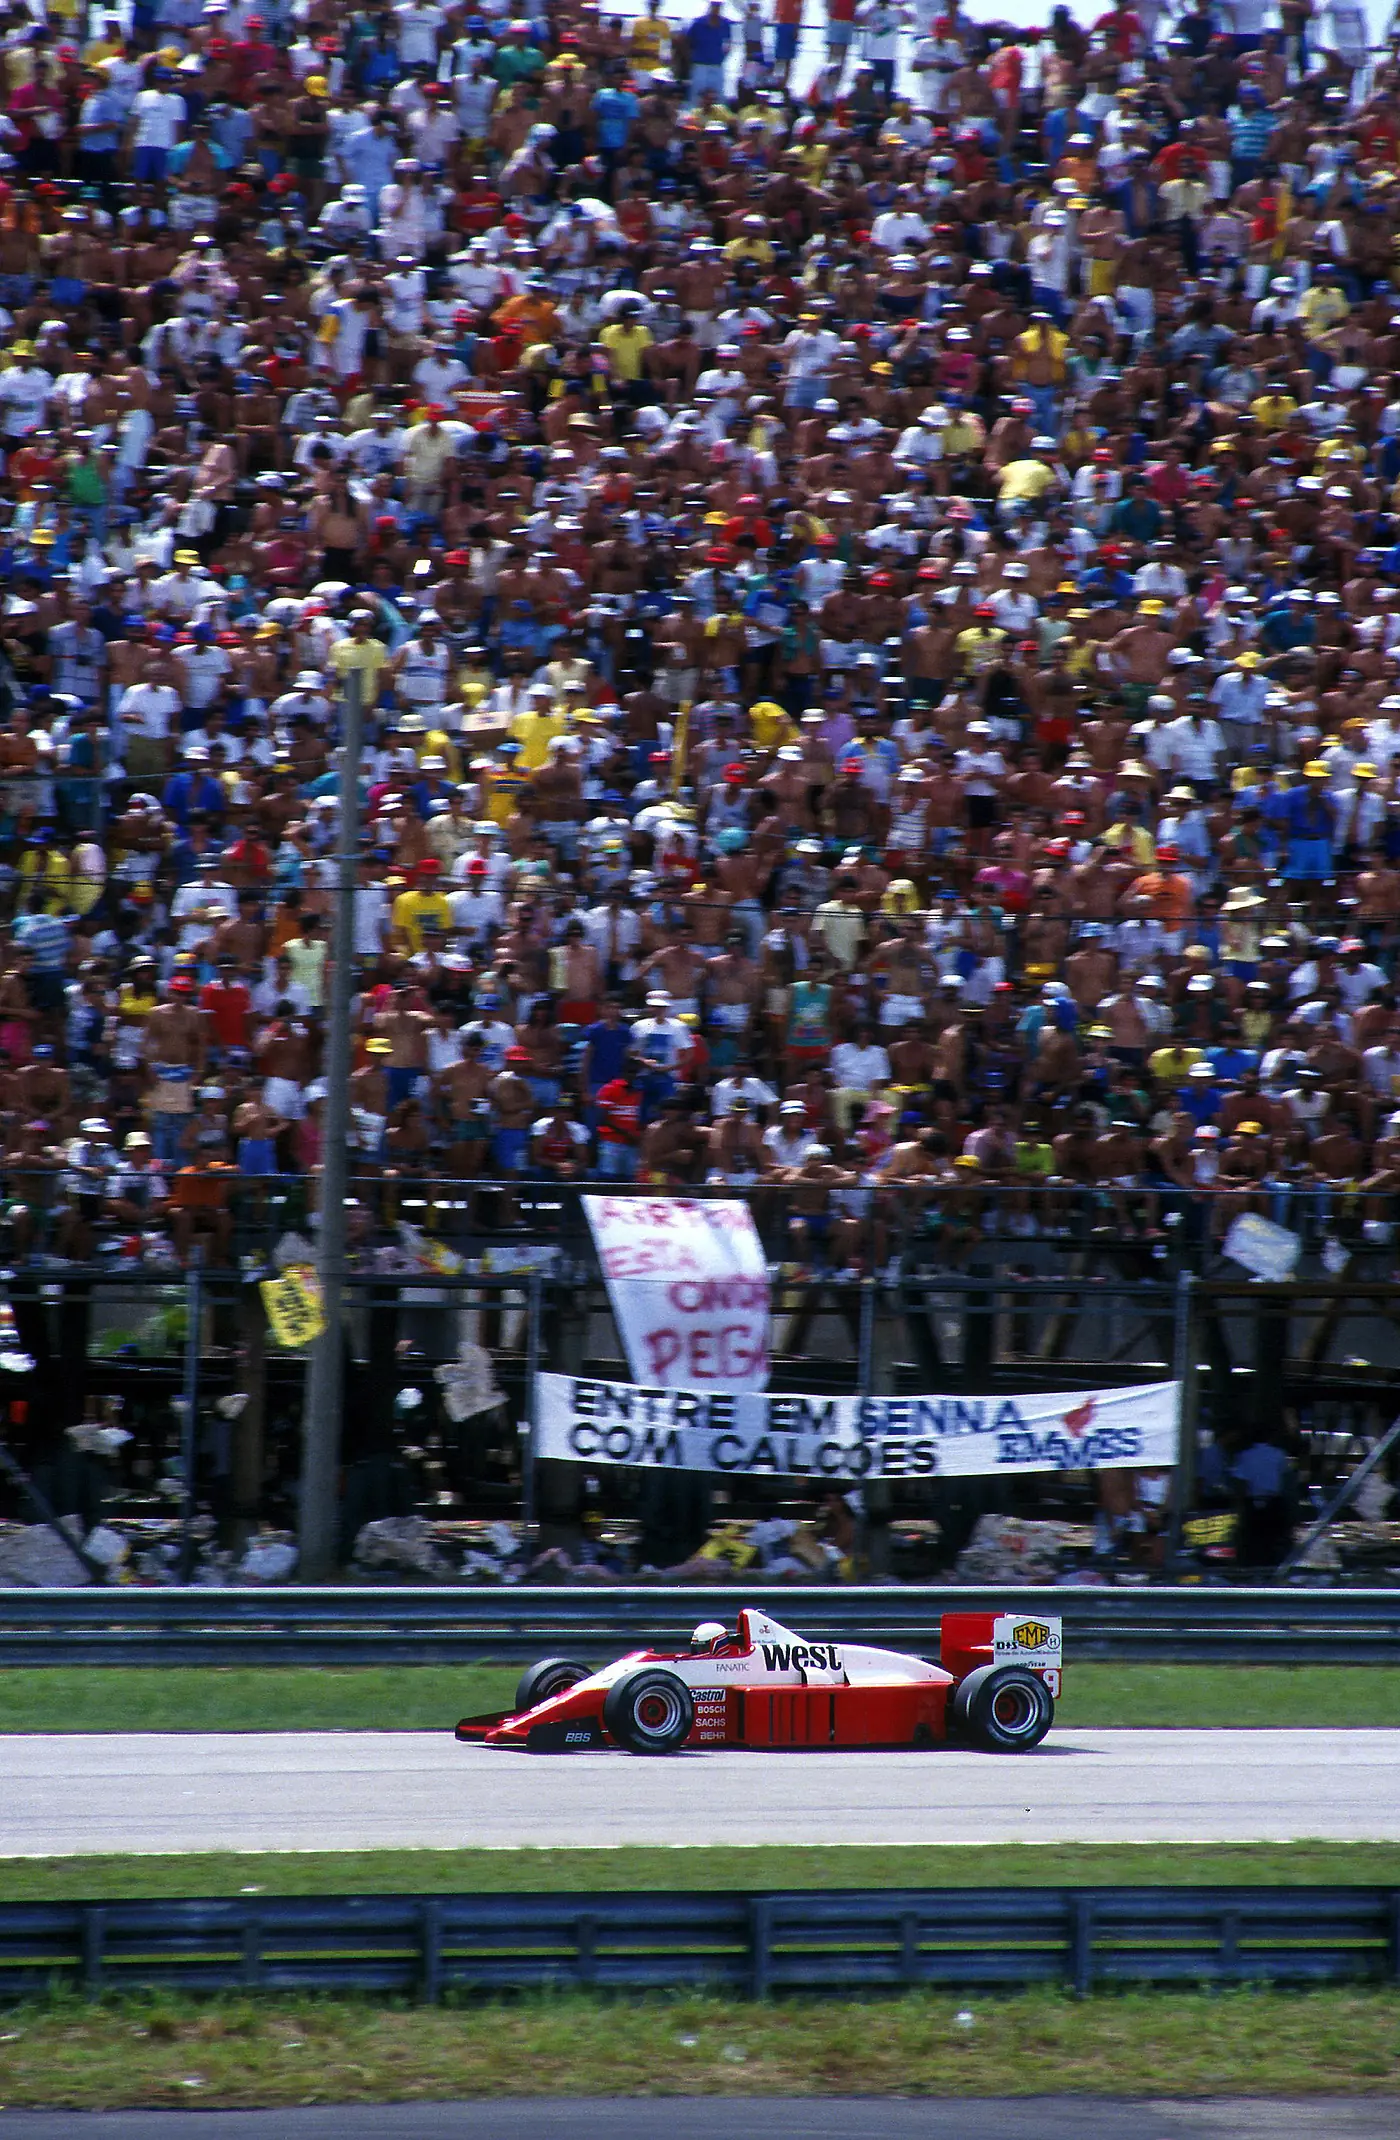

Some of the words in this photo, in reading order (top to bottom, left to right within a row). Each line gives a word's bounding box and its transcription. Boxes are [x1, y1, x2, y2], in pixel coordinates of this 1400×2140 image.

[572, 1381, 737, 1430] ENTRE
[767, 1397, 838, 1435] EM
[855, 1400, 1031, 1435] SENNA
[569, 1421, 682, 1466] COM
[1016, 1626, 1049, 1647] EMB
[760, 1644, 842, 1672] West
[716, 1663, 749, 1672] FANATIC
[690, 1689, 725, 1702] Castrol
[697, 1705, 726, 1714] BOSCH
[695, 1718, 726, 1727] SACHS
[565, 1732, 592, 1743] BBS
[700, 1731, 726, 1740] BEHR
